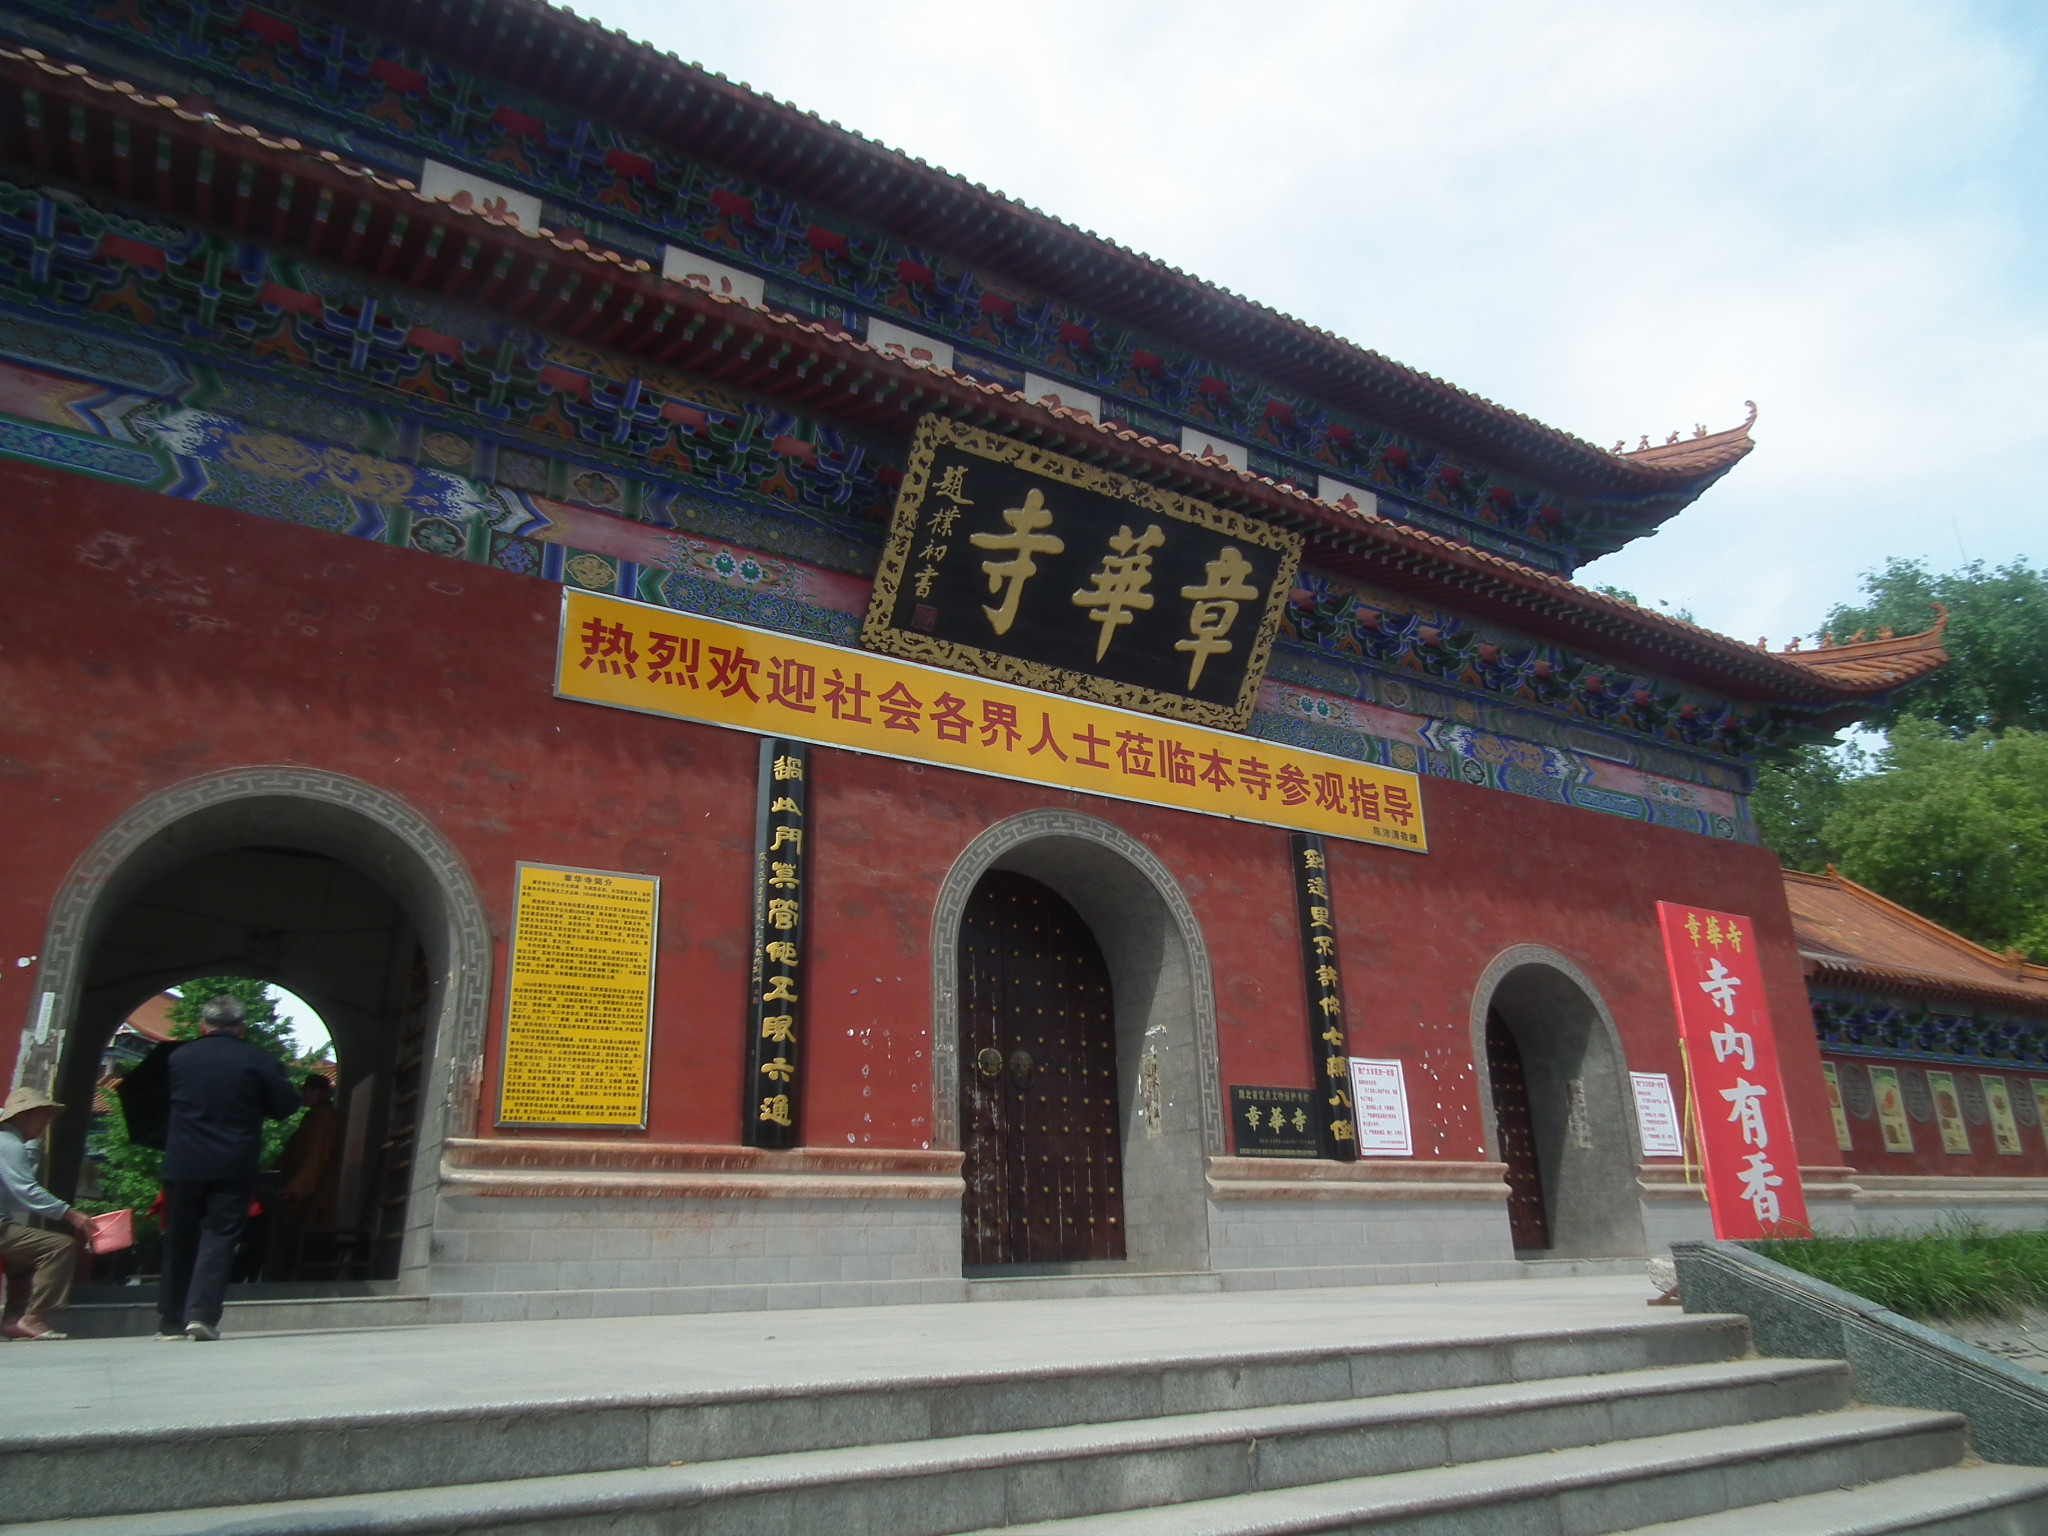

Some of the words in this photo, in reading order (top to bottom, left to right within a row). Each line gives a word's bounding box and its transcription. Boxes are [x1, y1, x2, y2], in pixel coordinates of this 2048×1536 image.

[969, 488, 1258, 691] 章華寺
[580, 617, 1415, 827] 热烈欢迎社会各界人士莅临本寺参观指导
[1684, 912, 1742, 953] 章華寺
[1245, 1105, 1307, 1134] 章華寺
[1699, 957, 1782, 1224] 寺内有香
